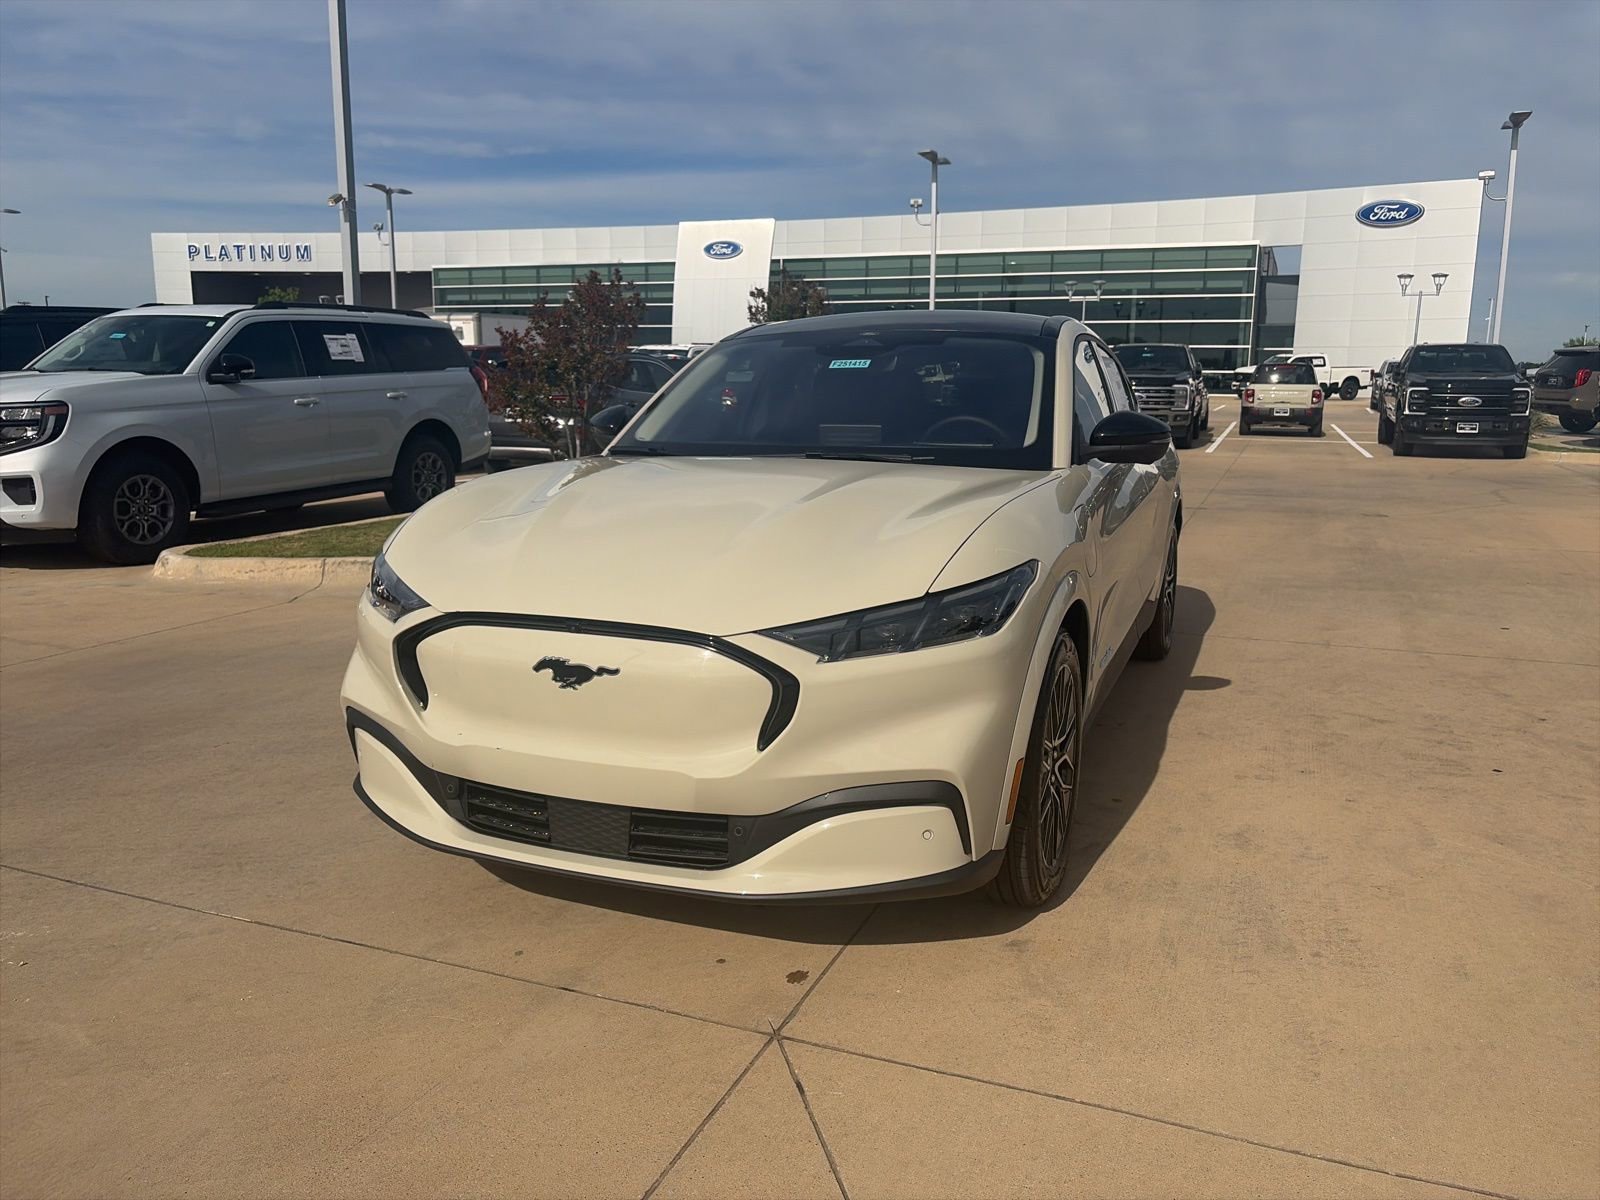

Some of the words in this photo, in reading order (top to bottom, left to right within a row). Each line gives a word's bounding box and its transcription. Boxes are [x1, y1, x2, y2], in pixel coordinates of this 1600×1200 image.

[1369, 204, 1409, 220] Ford
[187, 244, 312, 261] PLATINUM
[710, 243, 733, 254] Ford
